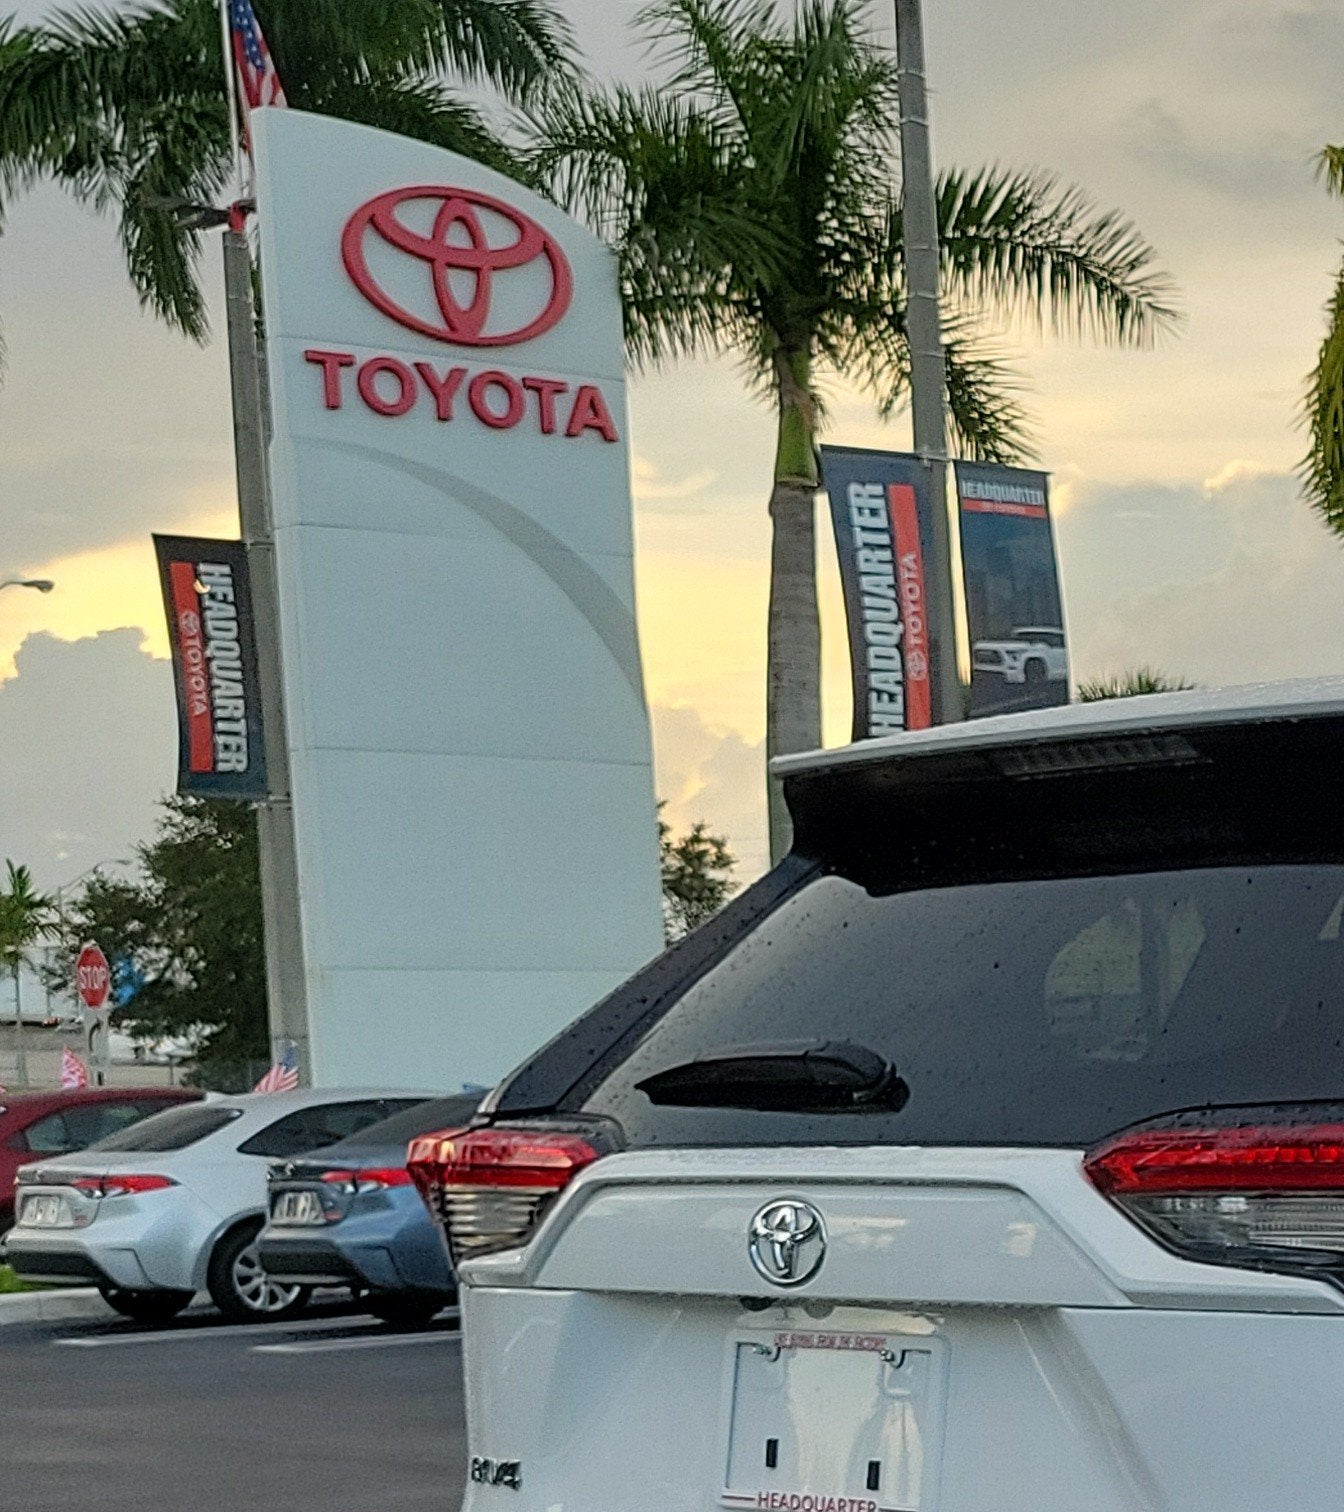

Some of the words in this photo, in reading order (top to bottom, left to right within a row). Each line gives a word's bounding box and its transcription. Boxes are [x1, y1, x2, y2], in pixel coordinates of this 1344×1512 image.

[304, 349, 618, 441] TOYOTA
[847, 482, 904, 738] HEADQUARTER
[902, 553, 926, 645] TOYOTA
[186, 640, 208, 717] TOYOTA
[197, 562, 249, 773] HEADQUARTER
[79, 965, 108, 990] STOP
